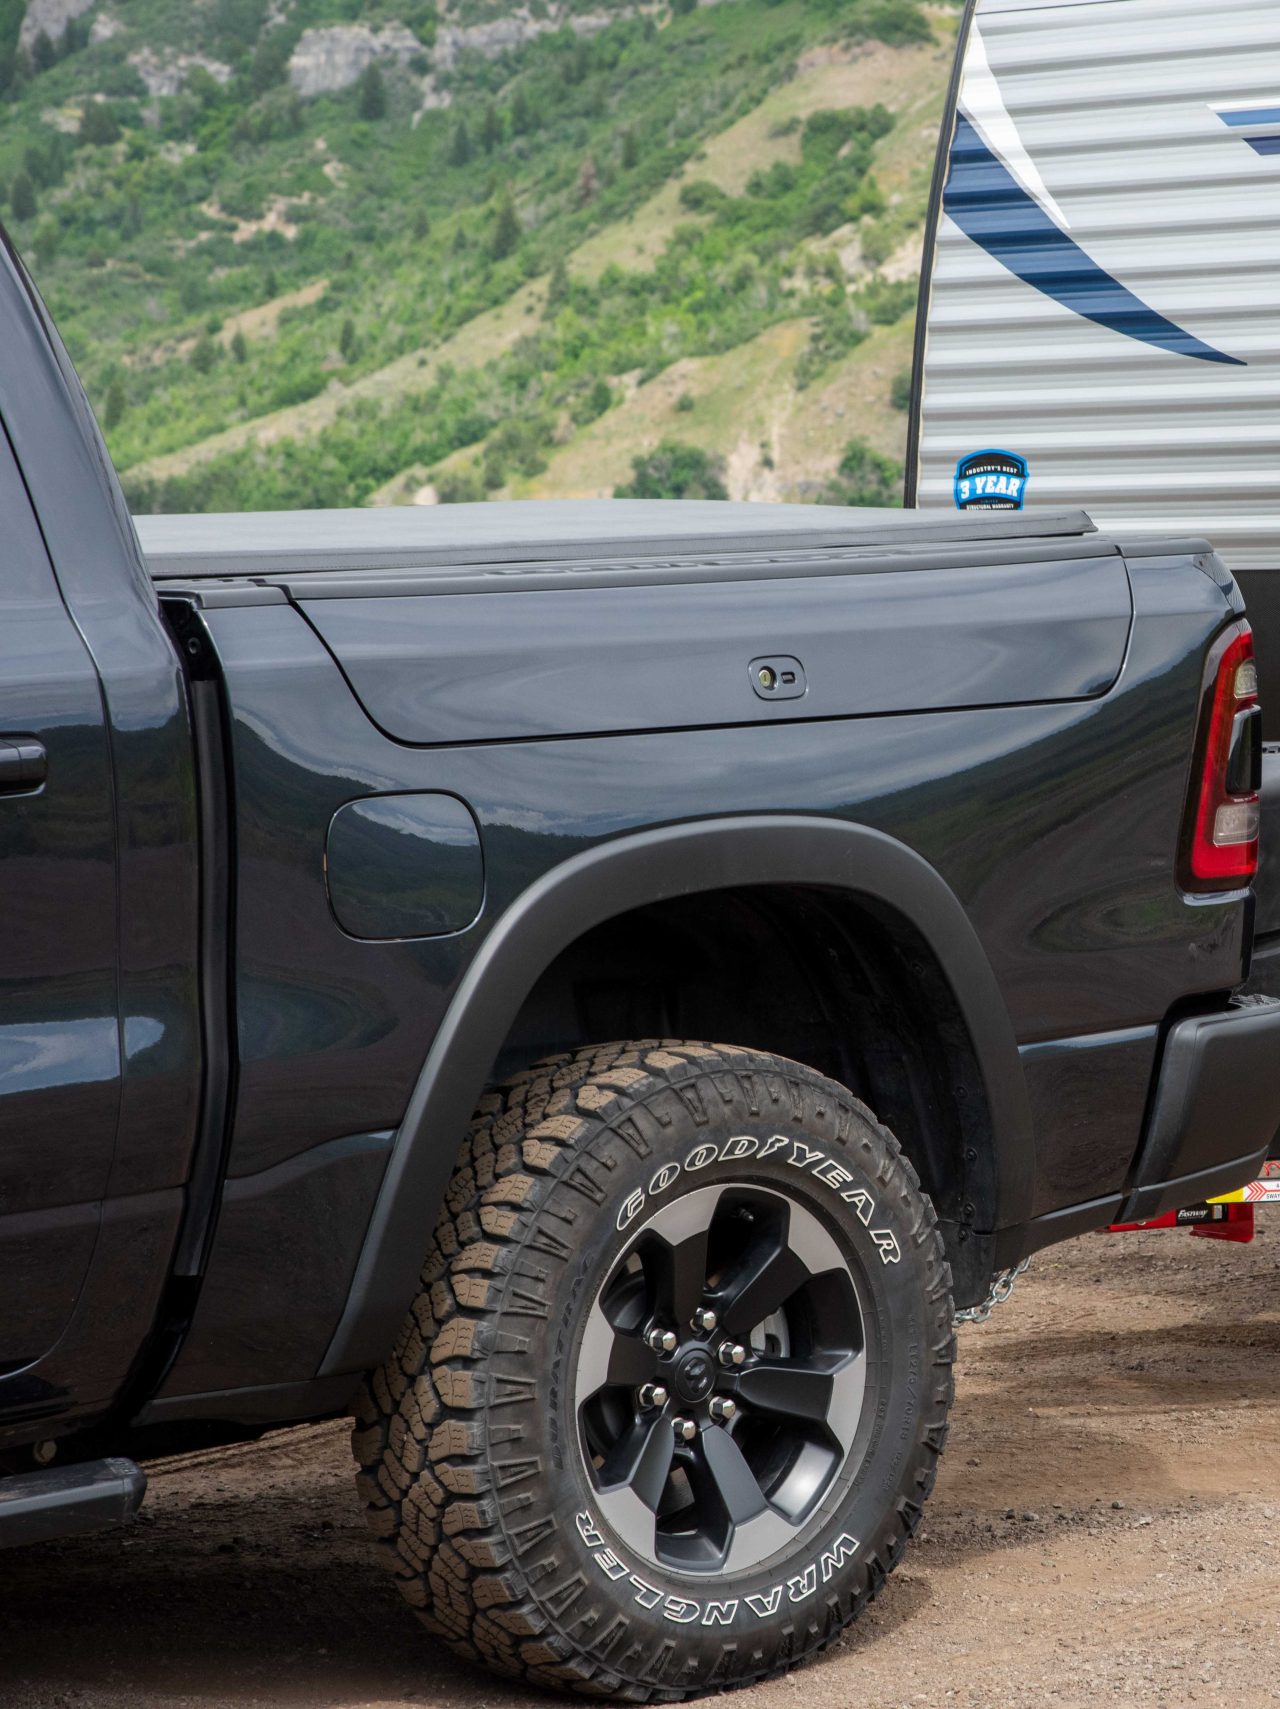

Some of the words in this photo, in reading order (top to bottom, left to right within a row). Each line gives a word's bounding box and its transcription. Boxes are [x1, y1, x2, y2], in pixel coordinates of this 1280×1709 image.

[960, 480, 970, 499] 3
[975, 475, 1021, 497] YEAR
[966, 465, 1001, 475] INDUSTRY'S
[1002, 466, 1018, 474] BEST
[616, 1135, 902, 1265] GOODYEAR
[575, 1510, 860, 1626] WRANGLER
